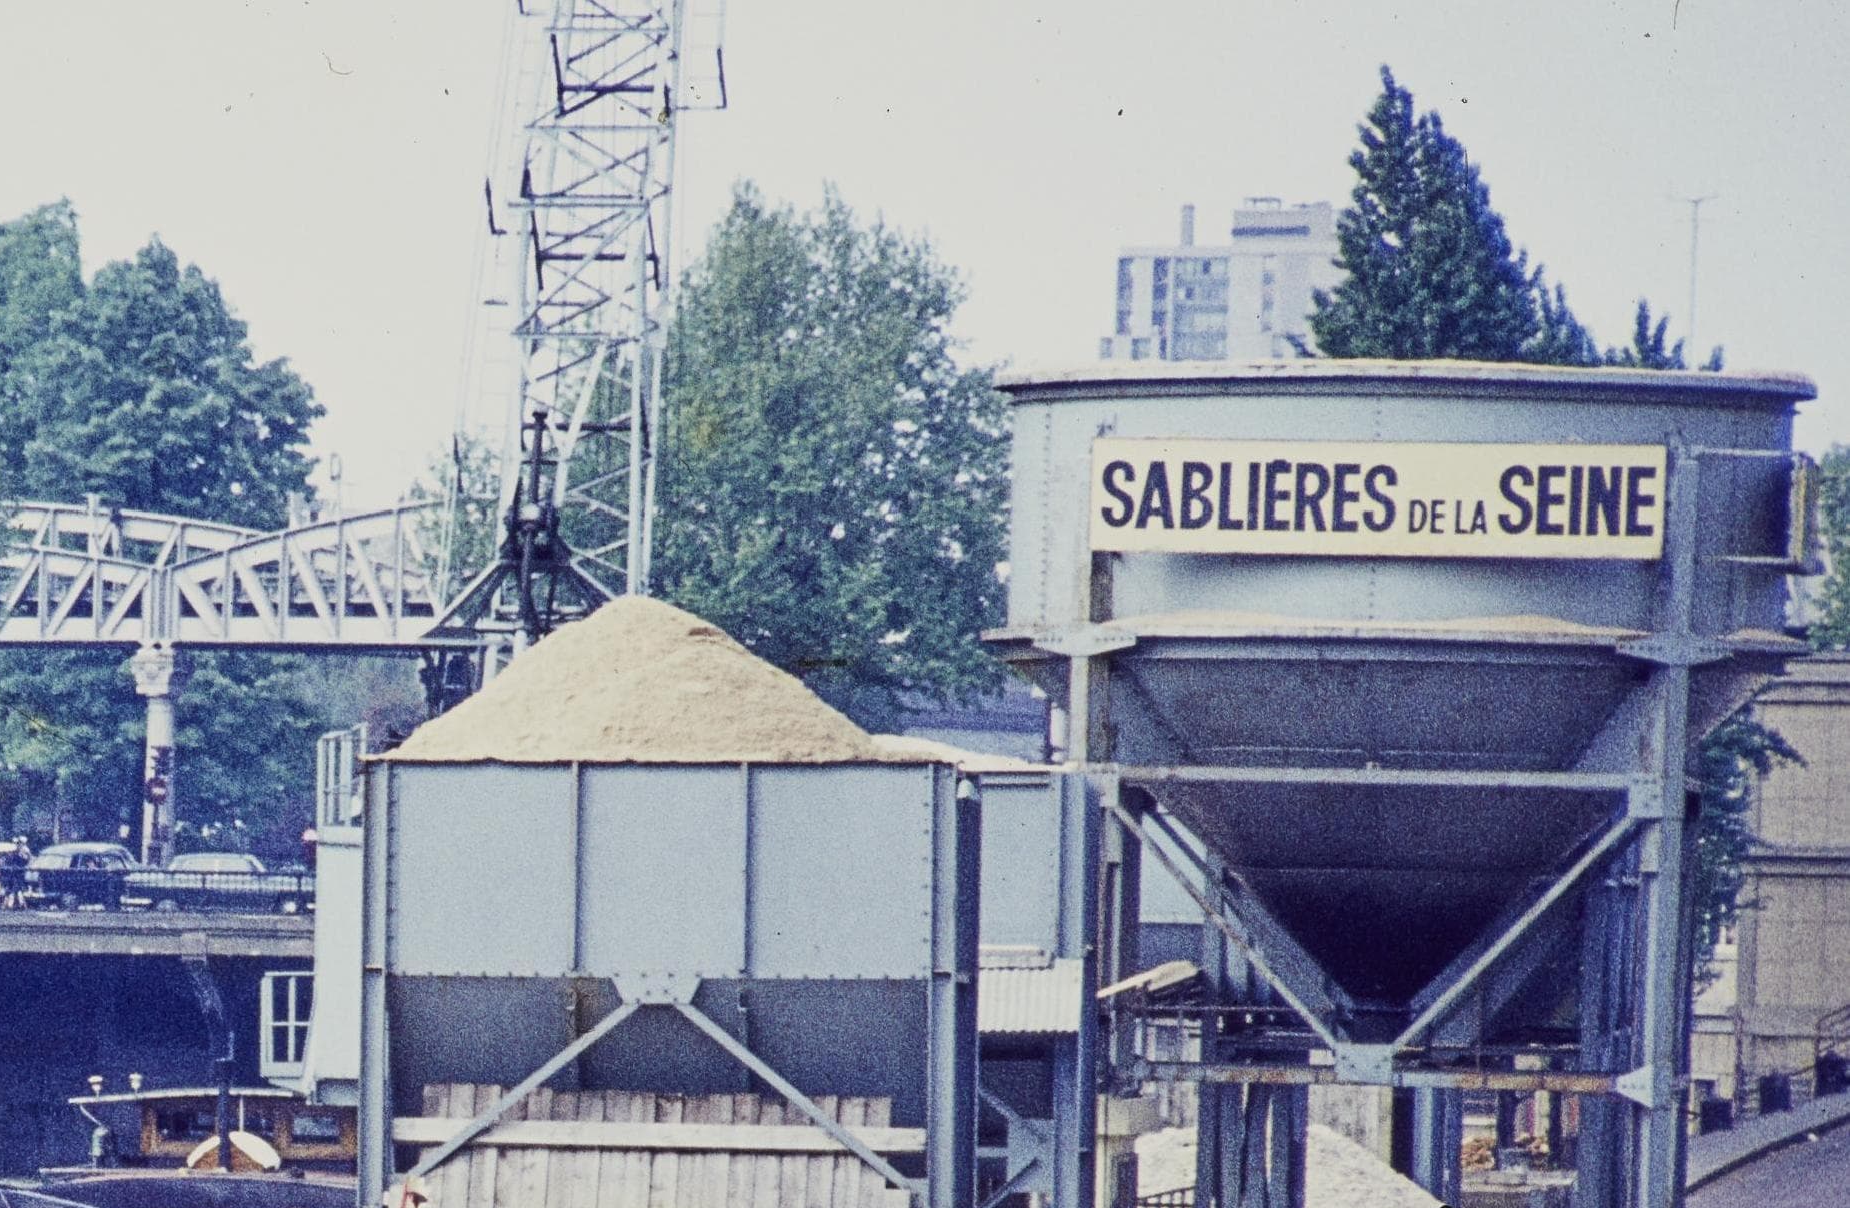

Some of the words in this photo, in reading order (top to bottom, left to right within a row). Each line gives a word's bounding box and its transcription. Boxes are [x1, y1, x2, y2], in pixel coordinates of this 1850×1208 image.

[1408, 499, 1446, 534] DE
[1454, 500, 1488, 535] LA
[1497, 464, 1657, 537] SEINE
